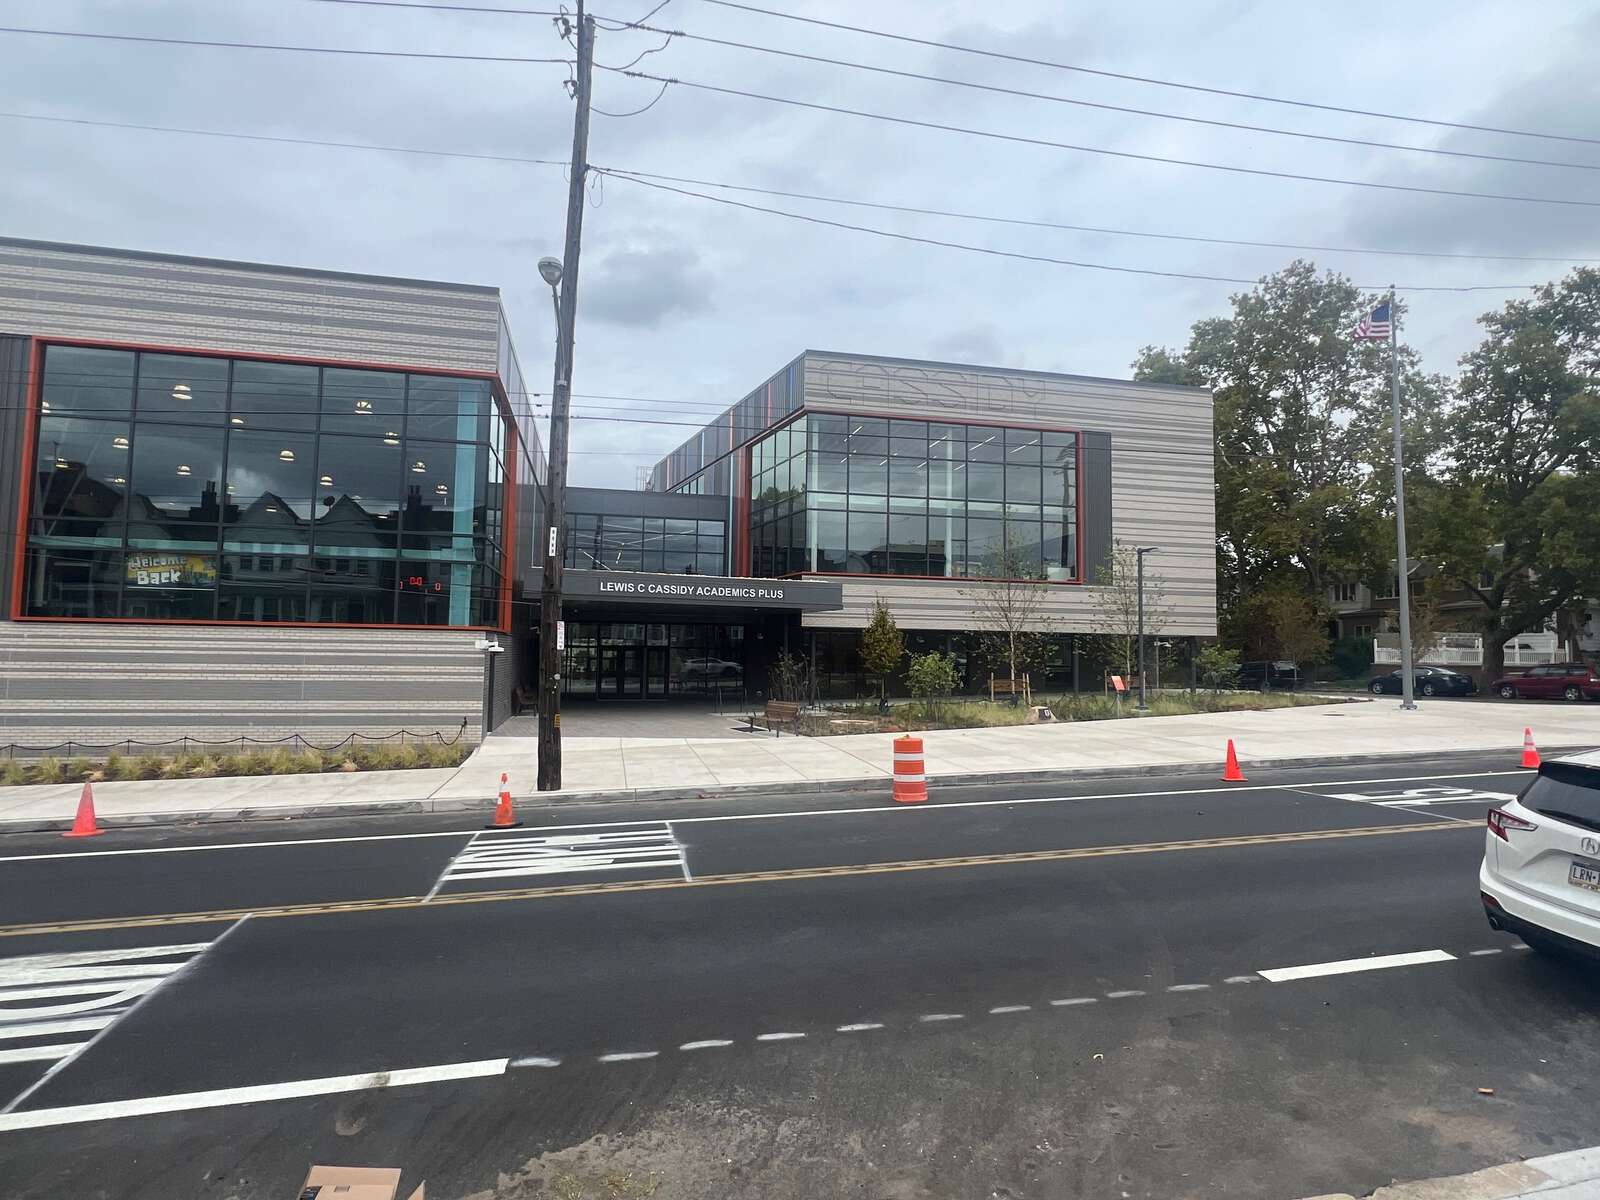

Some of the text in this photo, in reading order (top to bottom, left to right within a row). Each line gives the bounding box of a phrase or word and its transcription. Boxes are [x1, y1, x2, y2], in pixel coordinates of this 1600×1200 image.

[137, 569, 181, 584] Back
[600, 582, 784, 599] LEWIS C CASSIDY ACADEMICS PLUS
